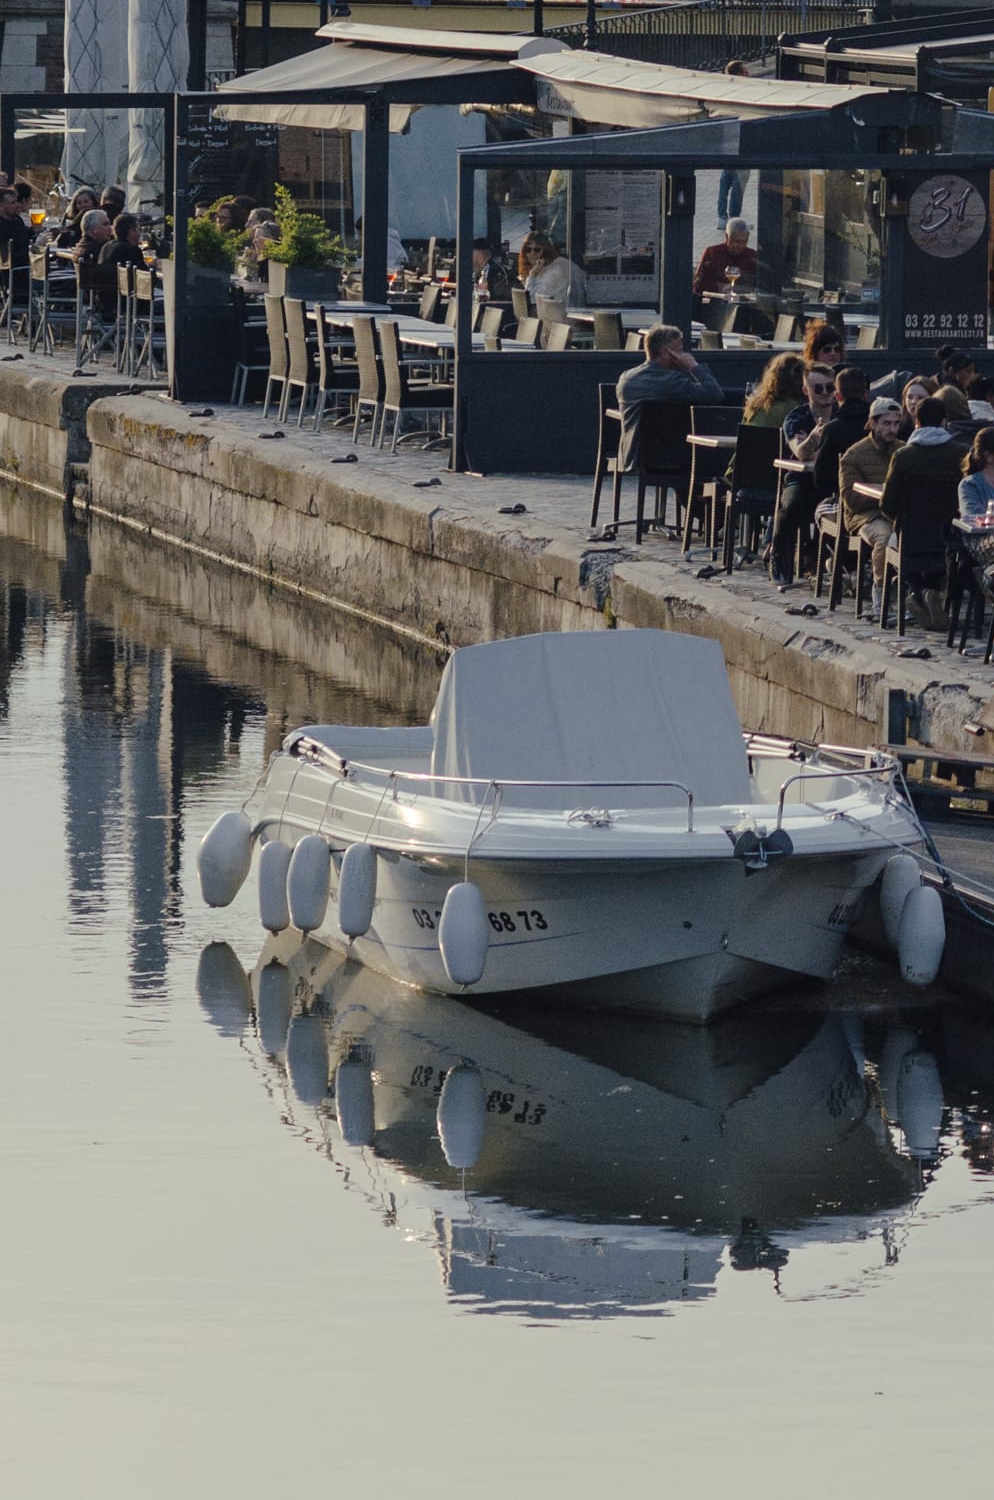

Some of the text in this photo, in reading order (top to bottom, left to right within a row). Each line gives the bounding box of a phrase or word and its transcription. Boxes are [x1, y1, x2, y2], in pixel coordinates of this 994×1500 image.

[905, 313, 985, 328] 03 22 92 12 12
[487, 909, 548, 933] 68 73
